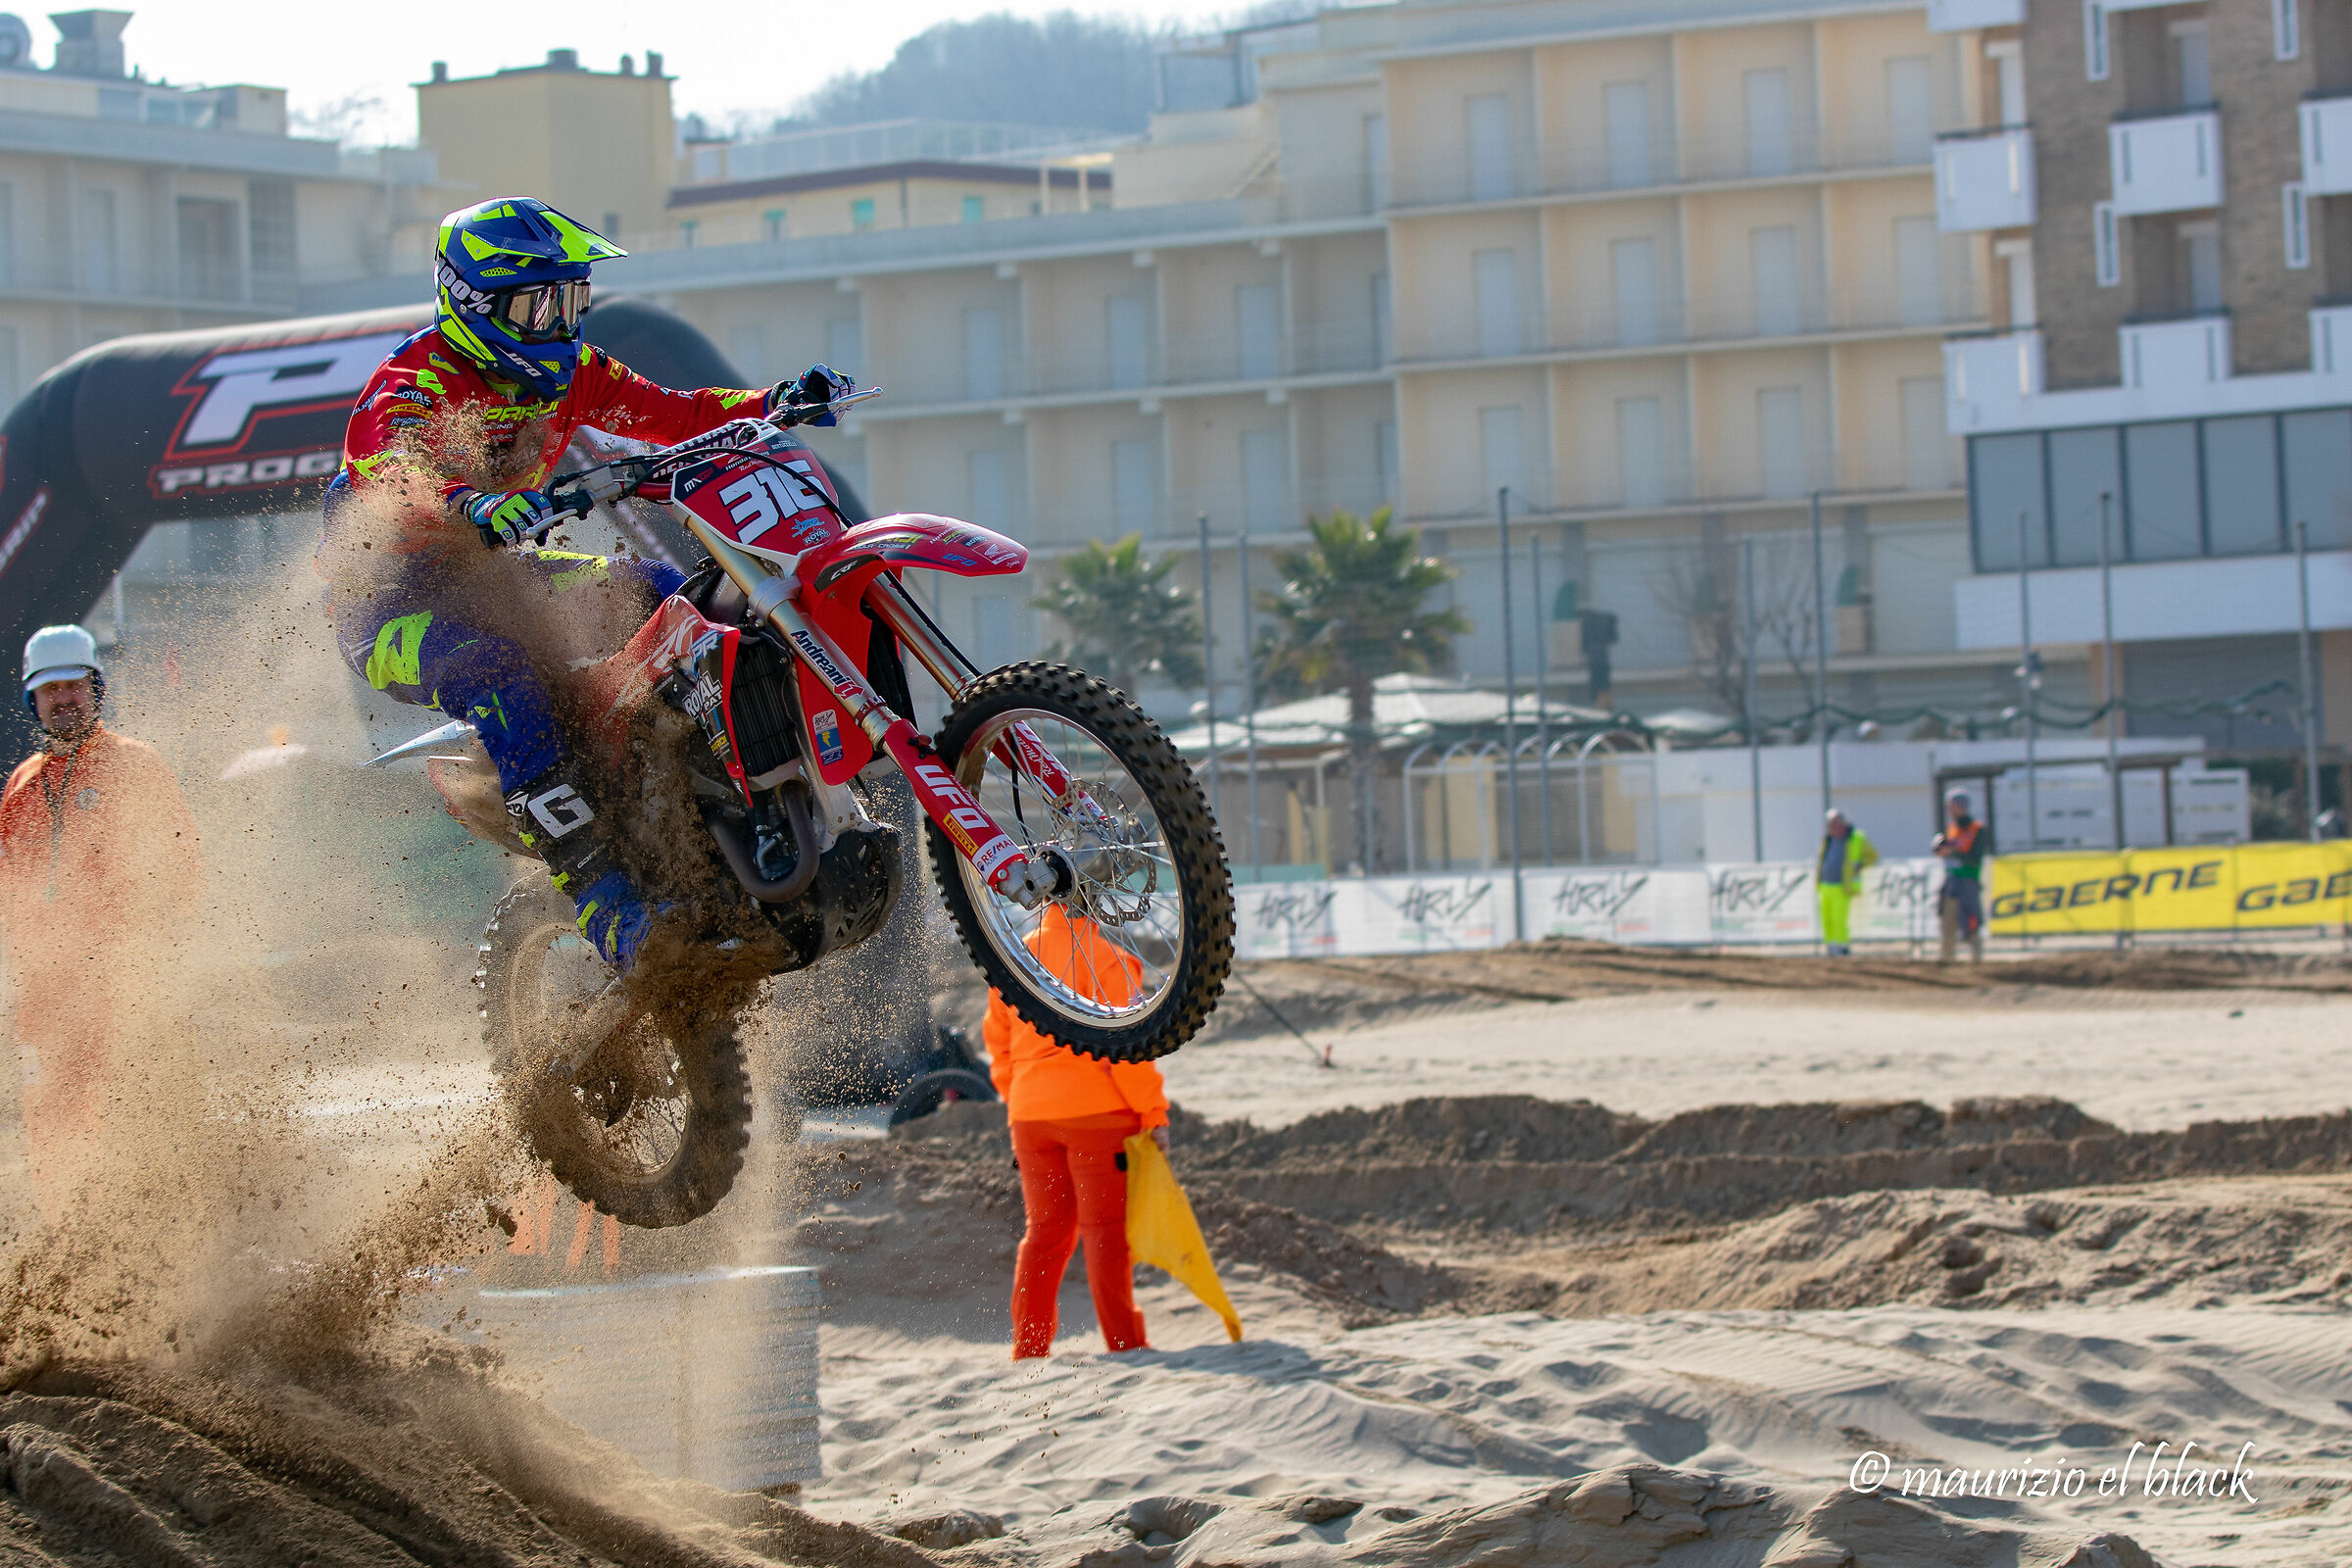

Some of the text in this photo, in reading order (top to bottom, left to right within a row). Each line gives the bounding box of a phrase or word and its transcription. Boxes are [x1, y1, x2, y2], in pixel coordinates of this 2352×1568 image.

[507, 352, 542, 377] UFO
[717, 459, 829, 547] 316
[942, 553, 978, 566] UFO
[790, 628, 851, 686] Andreani
[683, 671, 722, 717] ROYAL
[914, 764, 990, 830] UFO
[1990, 859, 2224, 920] GAERNE
